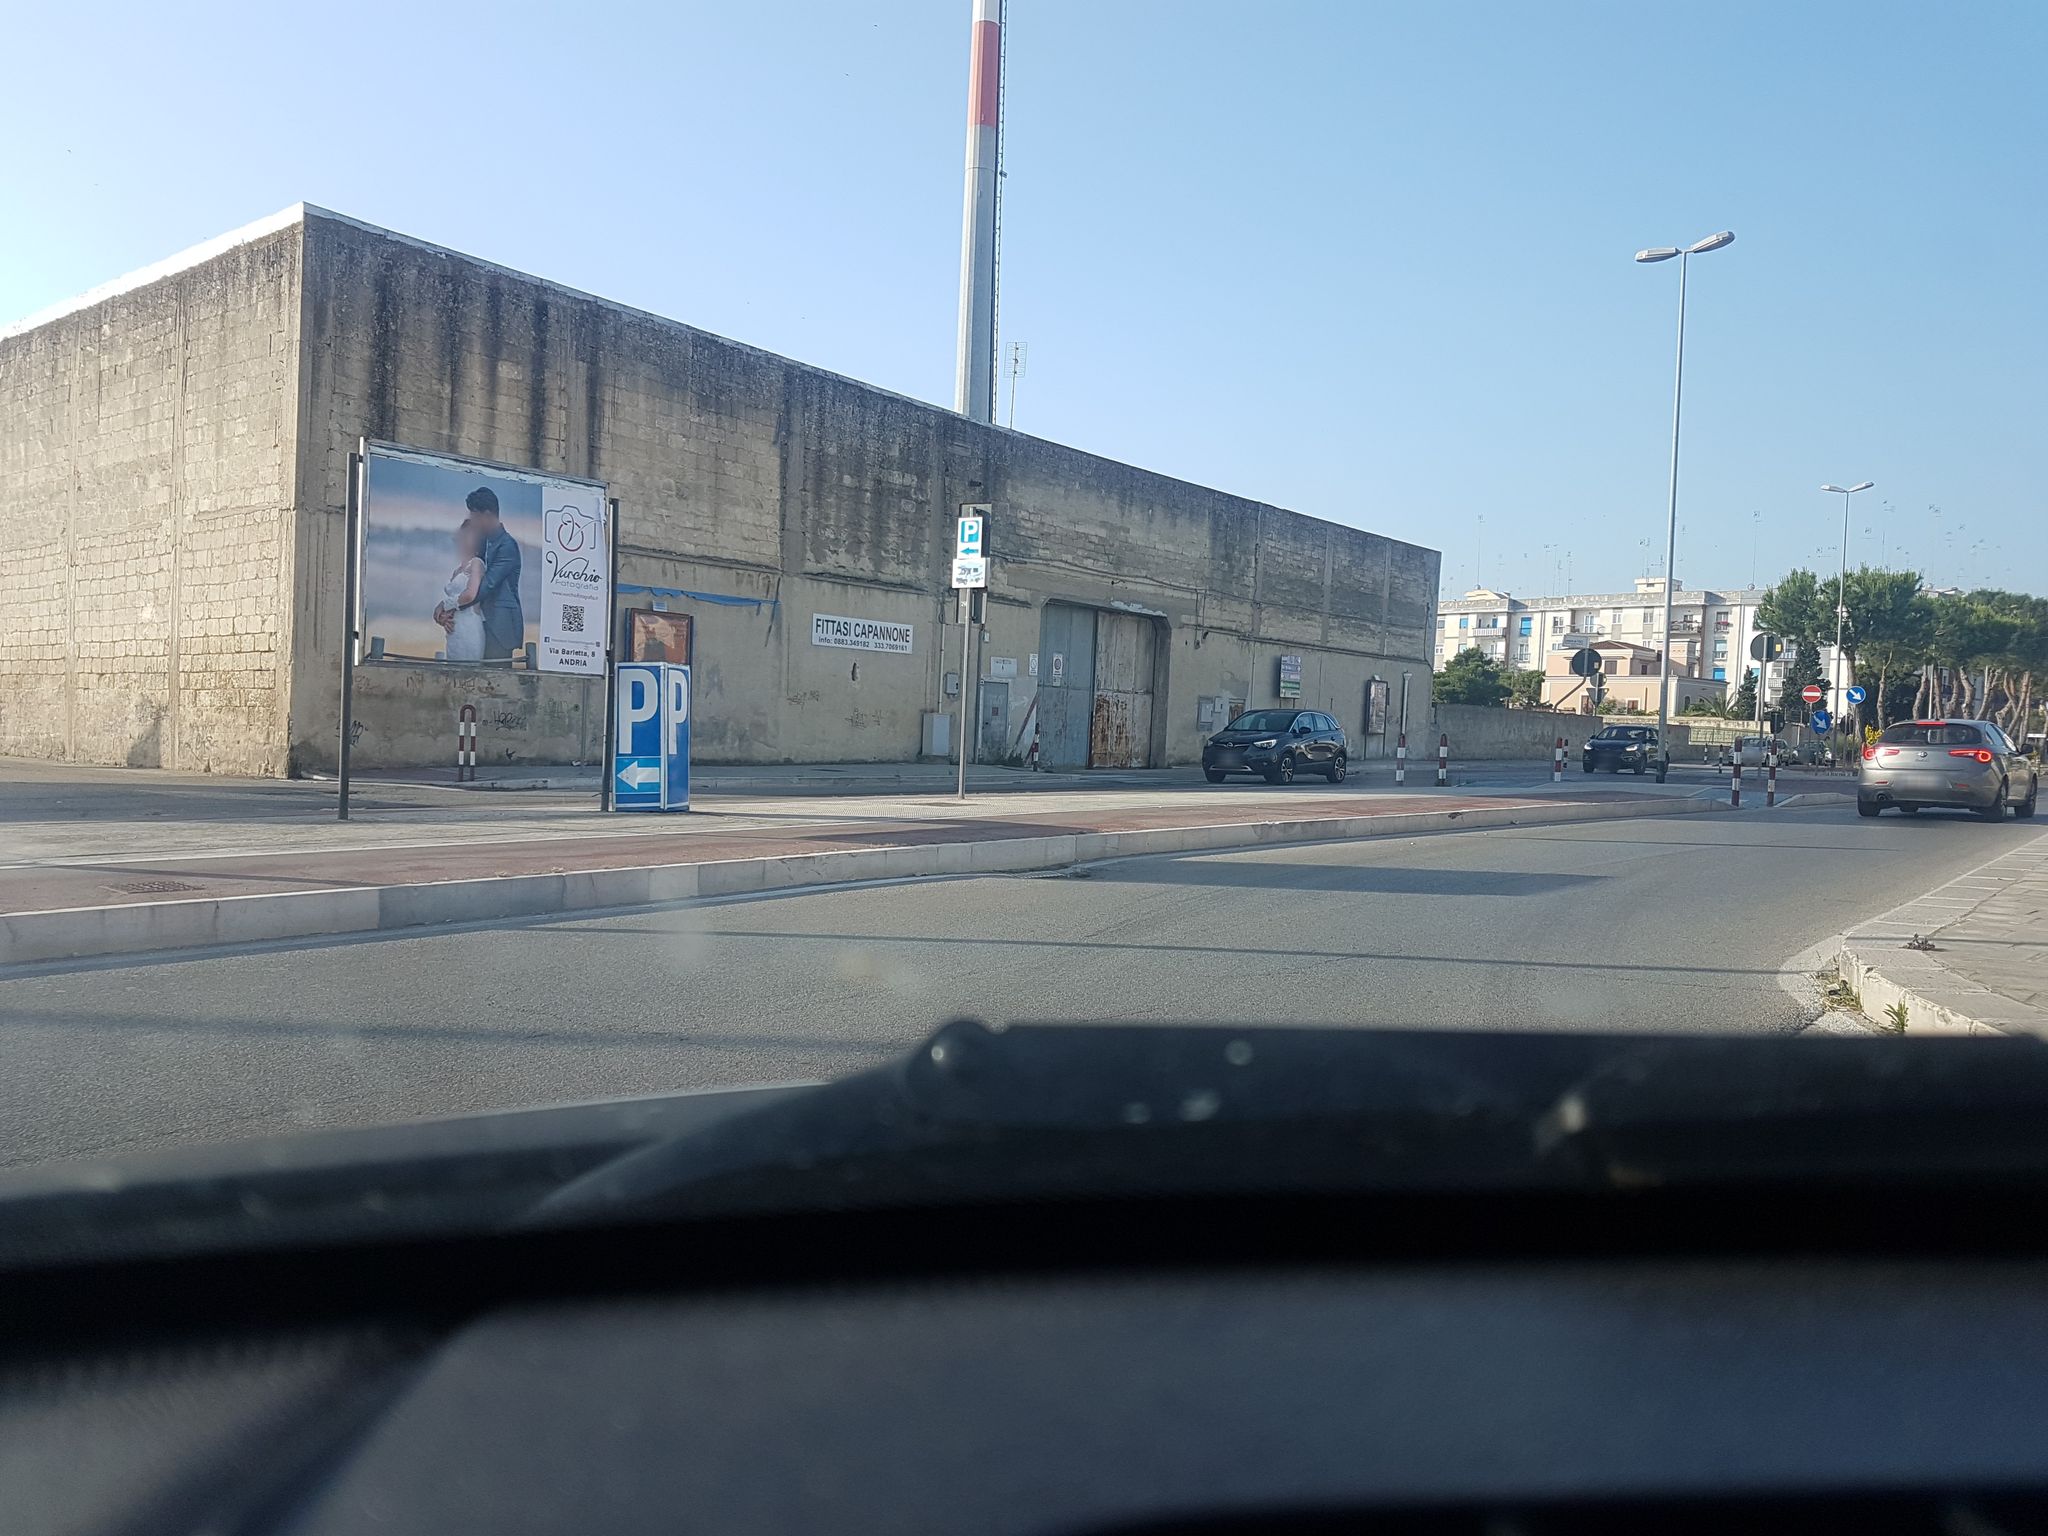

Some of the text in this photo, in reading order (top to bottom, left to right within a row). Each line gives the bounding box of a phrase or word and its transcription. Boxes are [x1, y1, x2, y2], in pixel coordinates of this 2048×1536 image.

[963, 520, 978, 543] P
[545, 551, 602, 583] Vurchio
[815, 618, 910, 643] FITTASI CAPANNONE
[559, 658, 587, 666] ANDRIA
[561, 649, 589, 658] Barletta,
[618, 668, 659, 754] P
[668, 669, 688, 755] P
